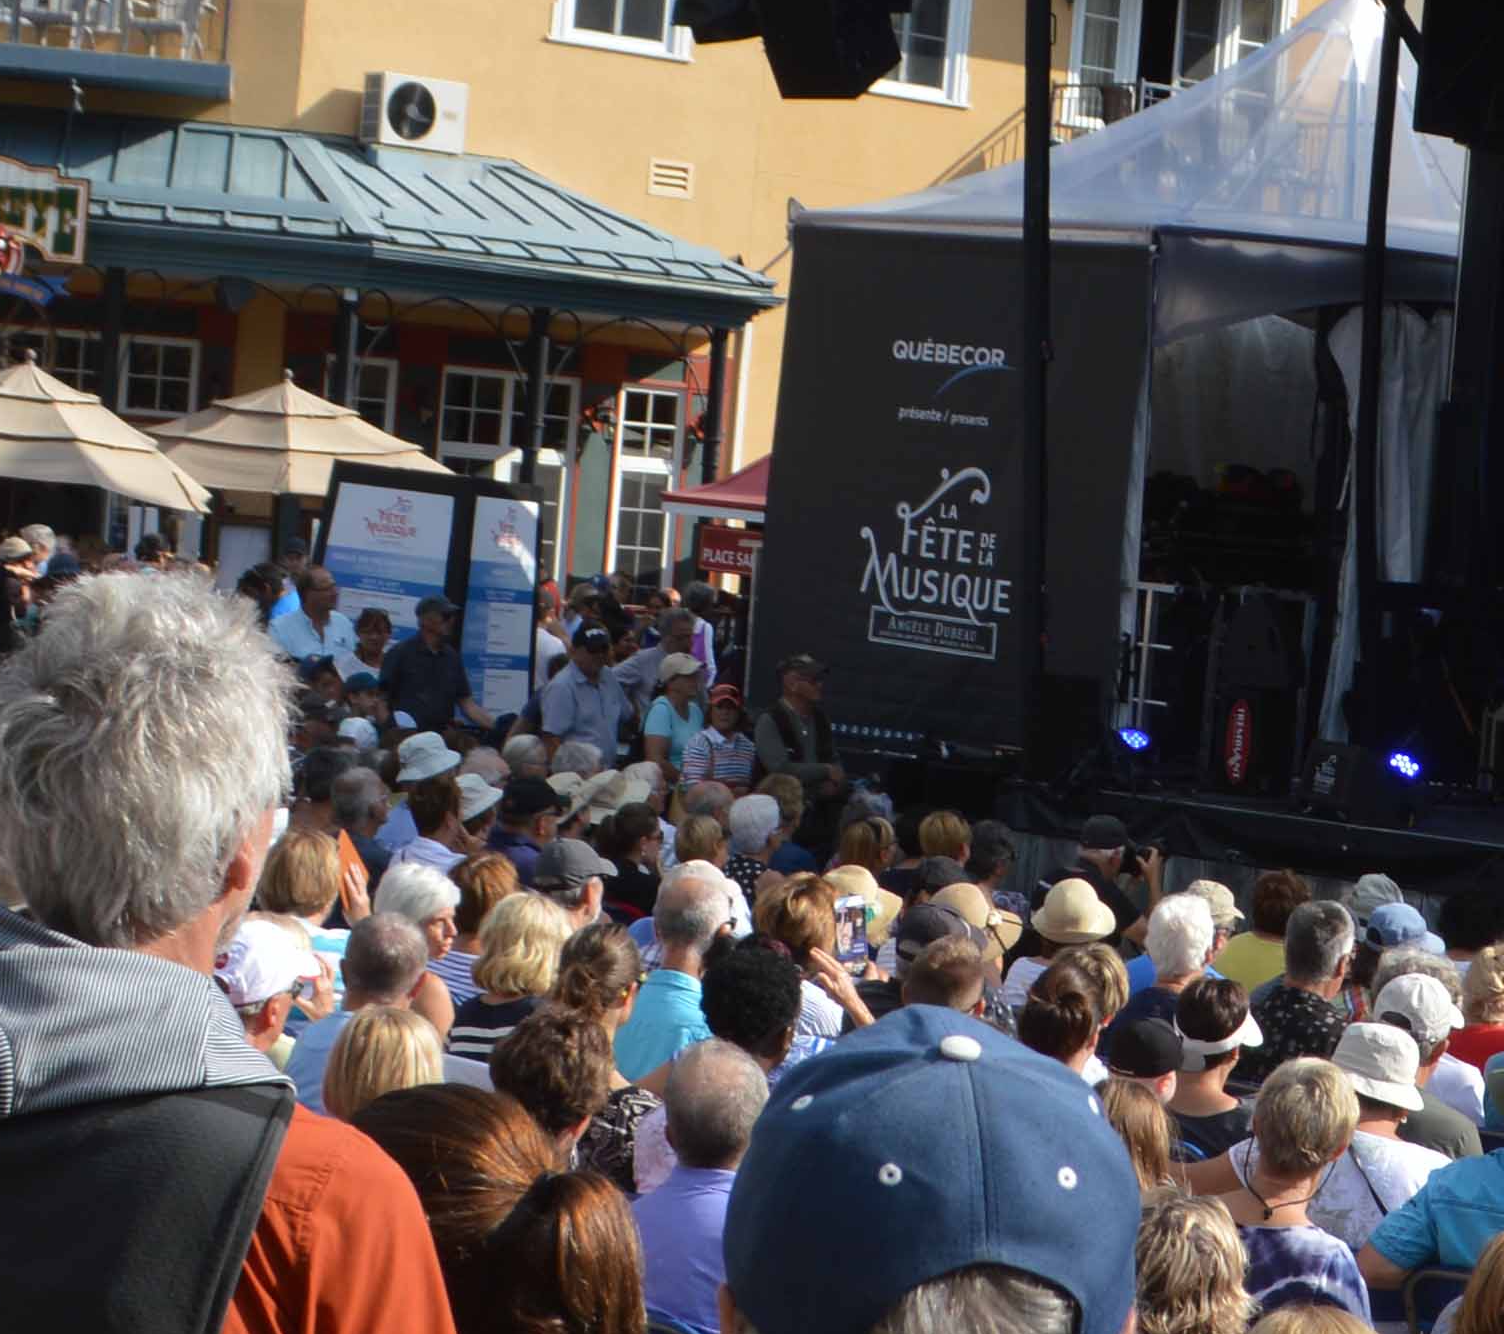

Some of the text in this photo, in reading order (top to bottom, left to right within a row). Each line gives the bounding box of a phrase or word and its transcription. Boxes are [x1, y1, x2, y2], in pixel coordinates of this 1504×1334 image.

[893, 338, 1006, 366] QUÉBECOR
[939, 502, 959, 520] LA
[899, 513, 997, 564] FÊTE DE
[978, 548, 995, 567] LA
[860, 526, 1013, 619] MUSIQUE
